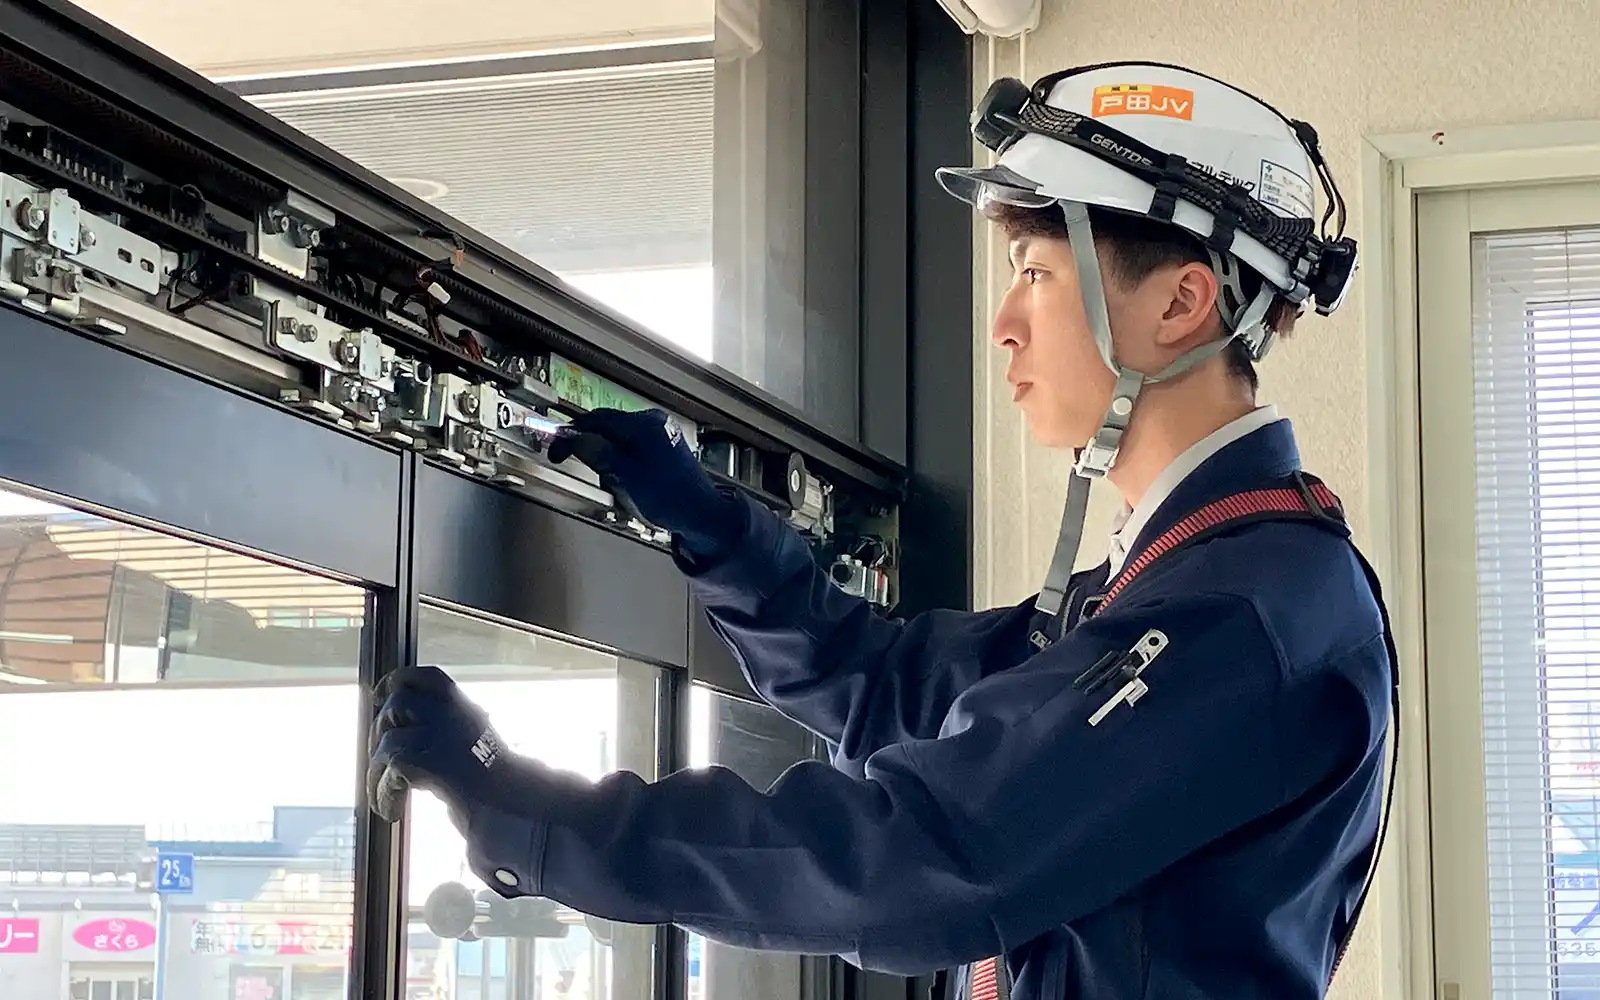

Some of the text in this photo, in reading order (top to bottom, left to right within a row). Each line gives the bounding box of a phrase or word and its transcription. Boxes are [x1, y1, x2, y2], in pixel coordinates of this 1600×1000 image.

[1099, 95, 1189, 114] 戸田JV
[162, 859, 180, 886] 25
[93, 933, 139, 950] さくら
